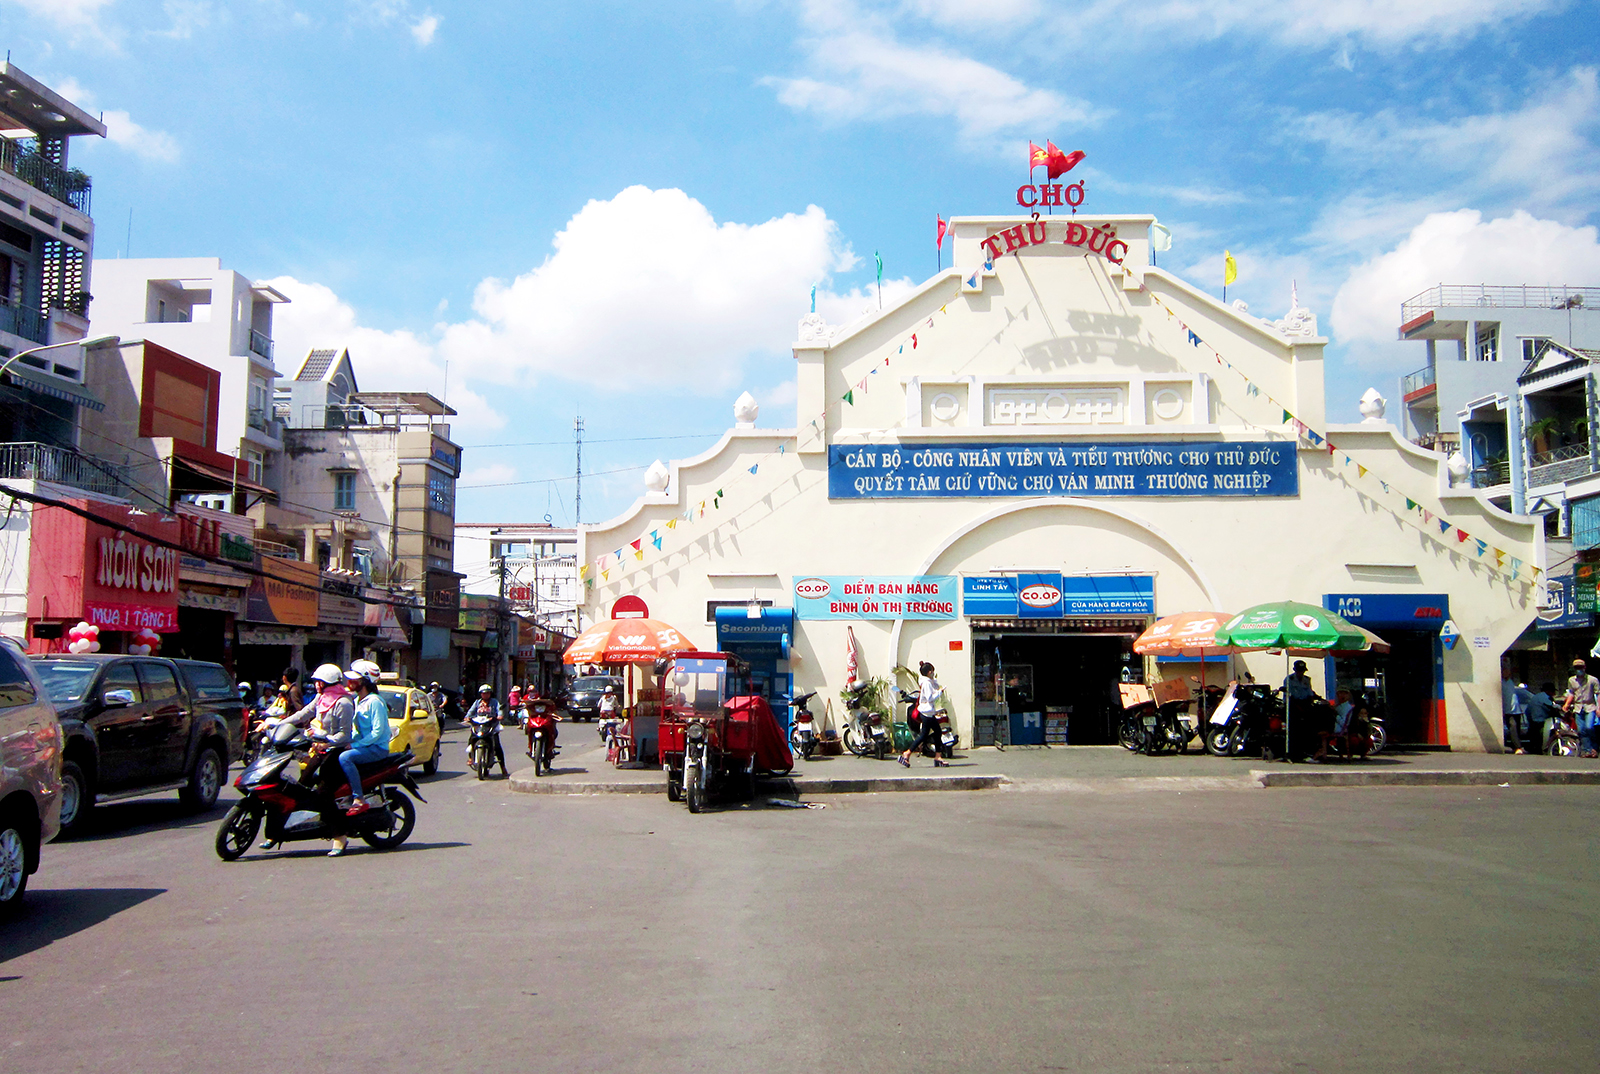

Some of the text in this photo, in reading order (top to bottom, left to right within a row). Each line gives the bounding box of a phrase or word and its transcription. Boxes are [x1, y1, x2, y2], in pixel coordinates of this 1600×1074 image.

[1016, 179, 1085, 213] CHỢ
[980, 212, 1129, 266] THỦ ĐỨC
[846, 448, 876, 468] CÁN
[882, 448, 902, 470] BỘ
[913, 448, 954, 468] CÔNG
[958, 448, 1001, 467] NHÂN
[1006, 447, 1043, 467] VIÊN
[1047, 447, 1067, 467] VÀ
[1072, 445, 1107, 467] TIỂU
[1112, 448, 1173, 466] THƯƠNG
[1214, 445, 1244, 466] THỦ
[1249, 446, 1281, 466] ĐỨC
[854, 469, 905, 495] QUYẾT
[908, 473, 941, 491] TÂM
[977, 471, 1018, 491] VỮNG
[1023, 473, 1054, 494] CHỢ
[1094, 475, 1135, 490] MINH
[1146, 471, 1209, 490] THƯƠNG
[1213, 470, 1272, 492] NGHIỆP
[98, 530, 140, 590] NÓN
[141, 544, 176, 593] SƠN
[267, 580, 285, 599] MAI
[285, 583, 317, 602] Fashion
[797, 585, 829, 593] CO.OP
[844, 578, 939, 595] ĐIỂM BÁN HÀNG
[993, 583, 1008, 591] TÂY
[1022, 591, 1059, 600] CO.OP
[830, 596, 953, 615] BÌNH ỔN THỊ TRƯỜNG
[1338, 598, 1362, 617] ACB
[1414, 607, 1443, 618] ATM
[92, 607, 121, 626] MUA
[720, 624, 788, 633] Sacombank
[1176, 618, 1218, 636] 3G
[657, 628, 680, 648] 3G
